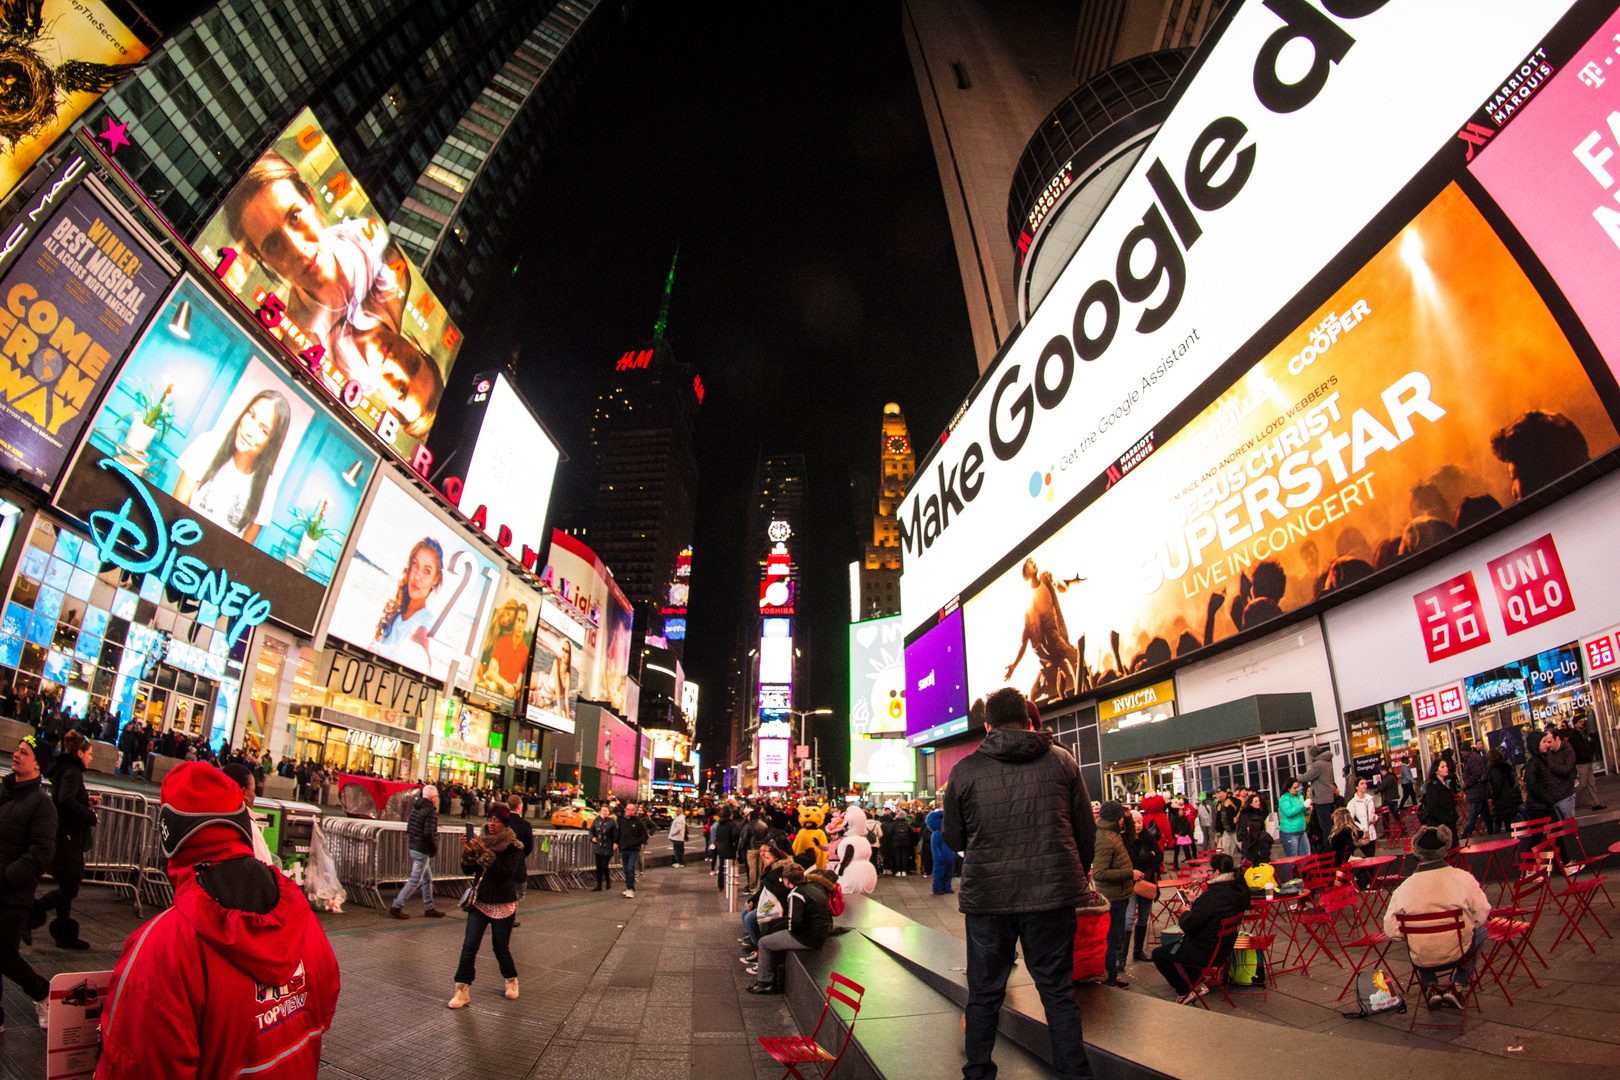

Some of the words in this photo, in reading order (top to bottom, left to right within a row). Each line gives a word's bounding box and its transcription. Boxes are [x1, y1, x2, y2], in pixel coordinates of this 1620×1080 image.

[69, 0, 128, 56] epTheSecrets
[1484, 47, 1548, 115] MARRIOTT
[1493, 64, 1552, 125] MARQUIS
[1028, 161, 1073, 224] MARRIOTT
[1031, 175, 1072, 233] MARQUIS
[51, 216, 95, 261] BEST
[85, 249, 146, 315] MUSICAL
[86, 217, 143, 280] WINNER!
[42, 236, 60, 255] ALL
[56, 249, 88, 280] ACROSS
[83, 273, 109, 301] NORTH
[104, 292, 136, 326] AMERICA
[6, 282, 112, 381] COME
[899, 441, 986, 559] Make
[988, 115, 1257, 462] Google
[1288, 299, 1372, 376] COOPER
[1309, 311, 1338, 342] ALICE
[615, 349, 654, 371] H&M
[474, 392, 487, 402] LG
[1060, 447, 1079, 471] Get
[1080, 430, 1097, 453] the
[1098, 390, 1139, 434] Google
[1141, 326, 1202, 395] Assistant
[39, 430, 63, 448] BROADWAY
[1119, 431, 1155, 465] MARRIOTT
[1182, 481, 1200, 495] RICE
[1200, 466, 1218, 482] AND
[1218, 438, 1255, 471] ANDREW
[1255, 416, 1286, 443] LLOYD
[1286, 374, 1339, 419] WEBBER'S
[1250, 391, 1341, 479] CHRIST
[1121, 443, 1154, 475] MARQUIS
[1141, 371, 1448, 595] SUPERSTAR
[1182, 560, 1228, 599] LIVE
[1226, 541, 1251, 576] IN
[1252, 471, 1375, 561] CONCERT
[1497, 549, 1551, 592] UNI
[430, 551, 501, 660] 21
[760, 607, 795, 615] TOSHIBA
[1507, 580, 1563, 625] QLO
[325, 651, 430, 719] FOREVER
[1441, 687, 1457, 700] UNI
[1530, 660, 1578, 685] Pop-Up
[1112, 688, 1157, 713] INVICTA
[1443, 698, 1461, 713] QLO
[344, 728, 391, 752] FOREVER
[388, 740, 402, 754] 21
[1362, 727, 1373, 736] Dry?
[1356, 757, 1379, 765] Temperature
[1357, 763, 1376, 772] Changing?
[295, 845, 310, 853] TRAS
[255, 991, 308, 1029] TOPVIEW
